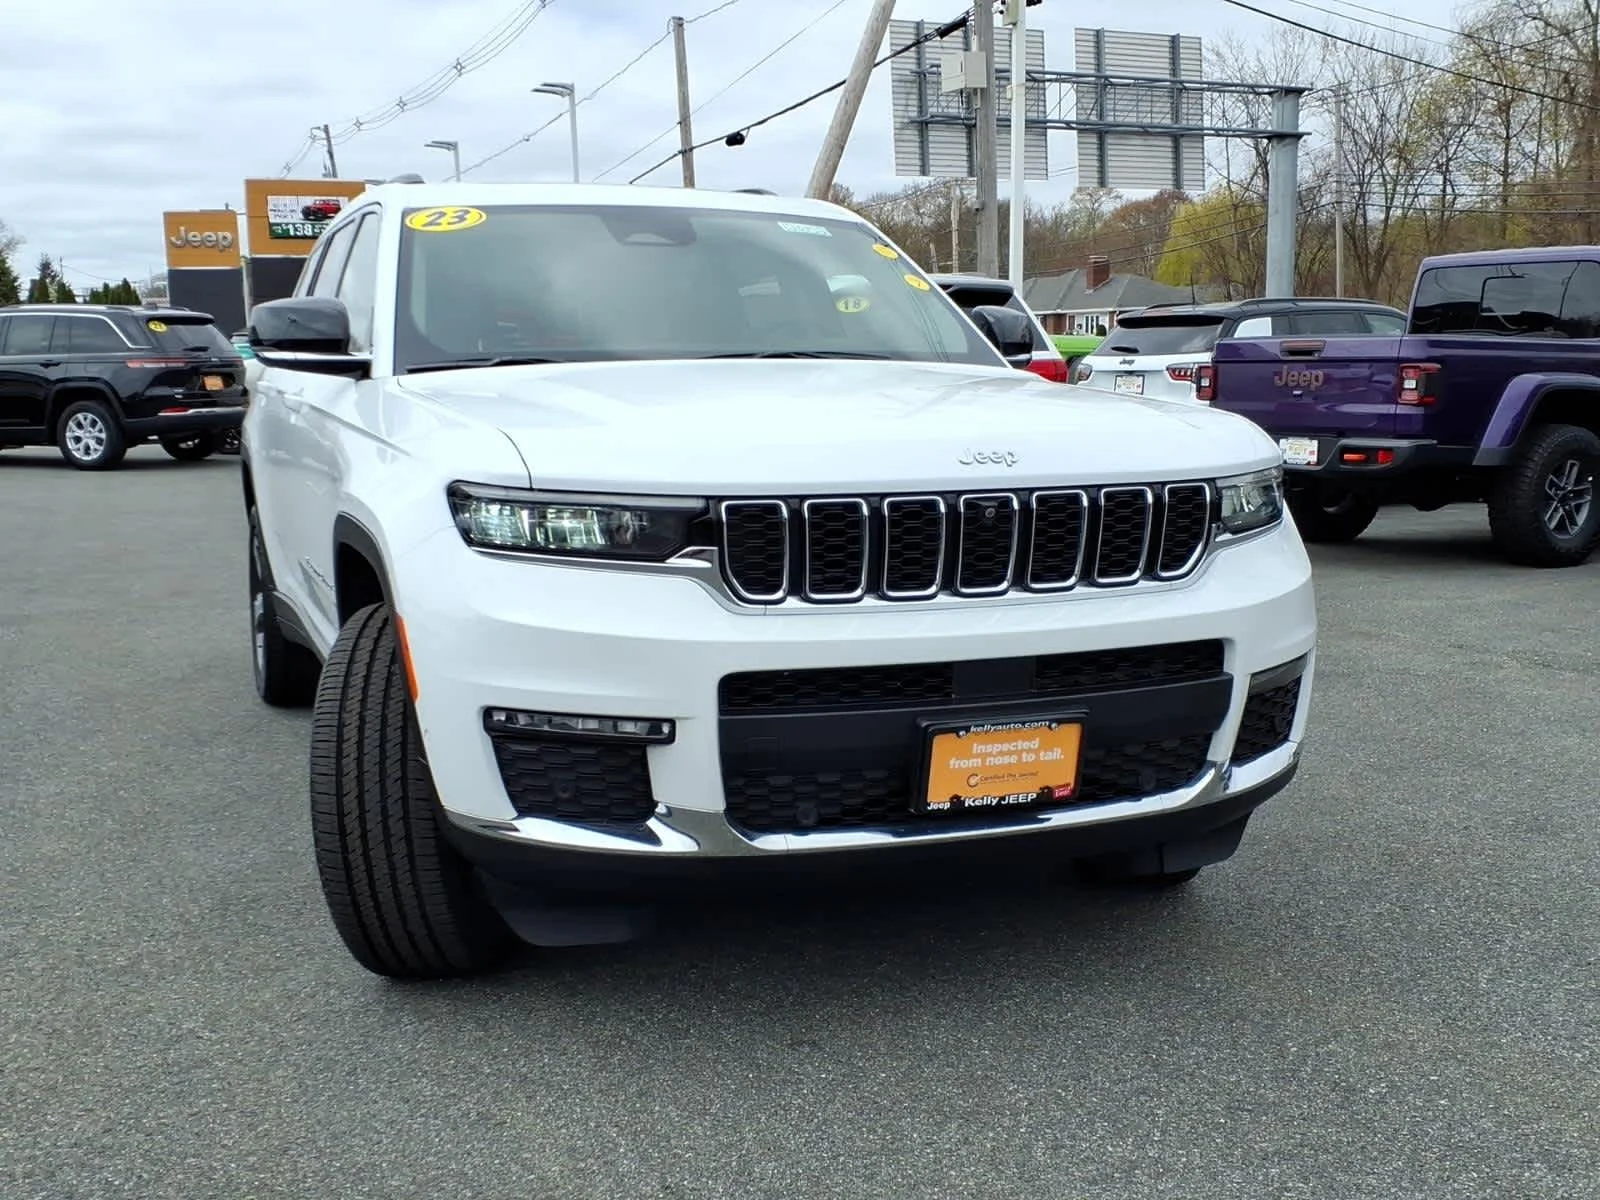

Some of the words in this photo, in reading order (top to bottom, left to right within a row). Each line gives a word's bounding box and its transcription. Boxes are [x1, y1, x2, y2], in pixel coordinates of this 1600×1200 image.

[427, 209, 465, 226] 23
[170, 226, 232, 251] Jeep
[1274, 366, 1325, 391] Jeep
[958, 447, 1019, 467] Jeep
[970, 721, 1049, 733] kellyauto.com
[972, 738, 1040, 754] Inspected
[949, 757, 982, 769] from
[985, 754, 1018, 766] nose
[1022, 752, 1036, 763] to
[1039, 747, 1065, 761] tail.
[927, 801, 951, 811] Jeep
[964, 795, 1000, 808] Kelly
[1001, 792, 1037, 805] JEEP
